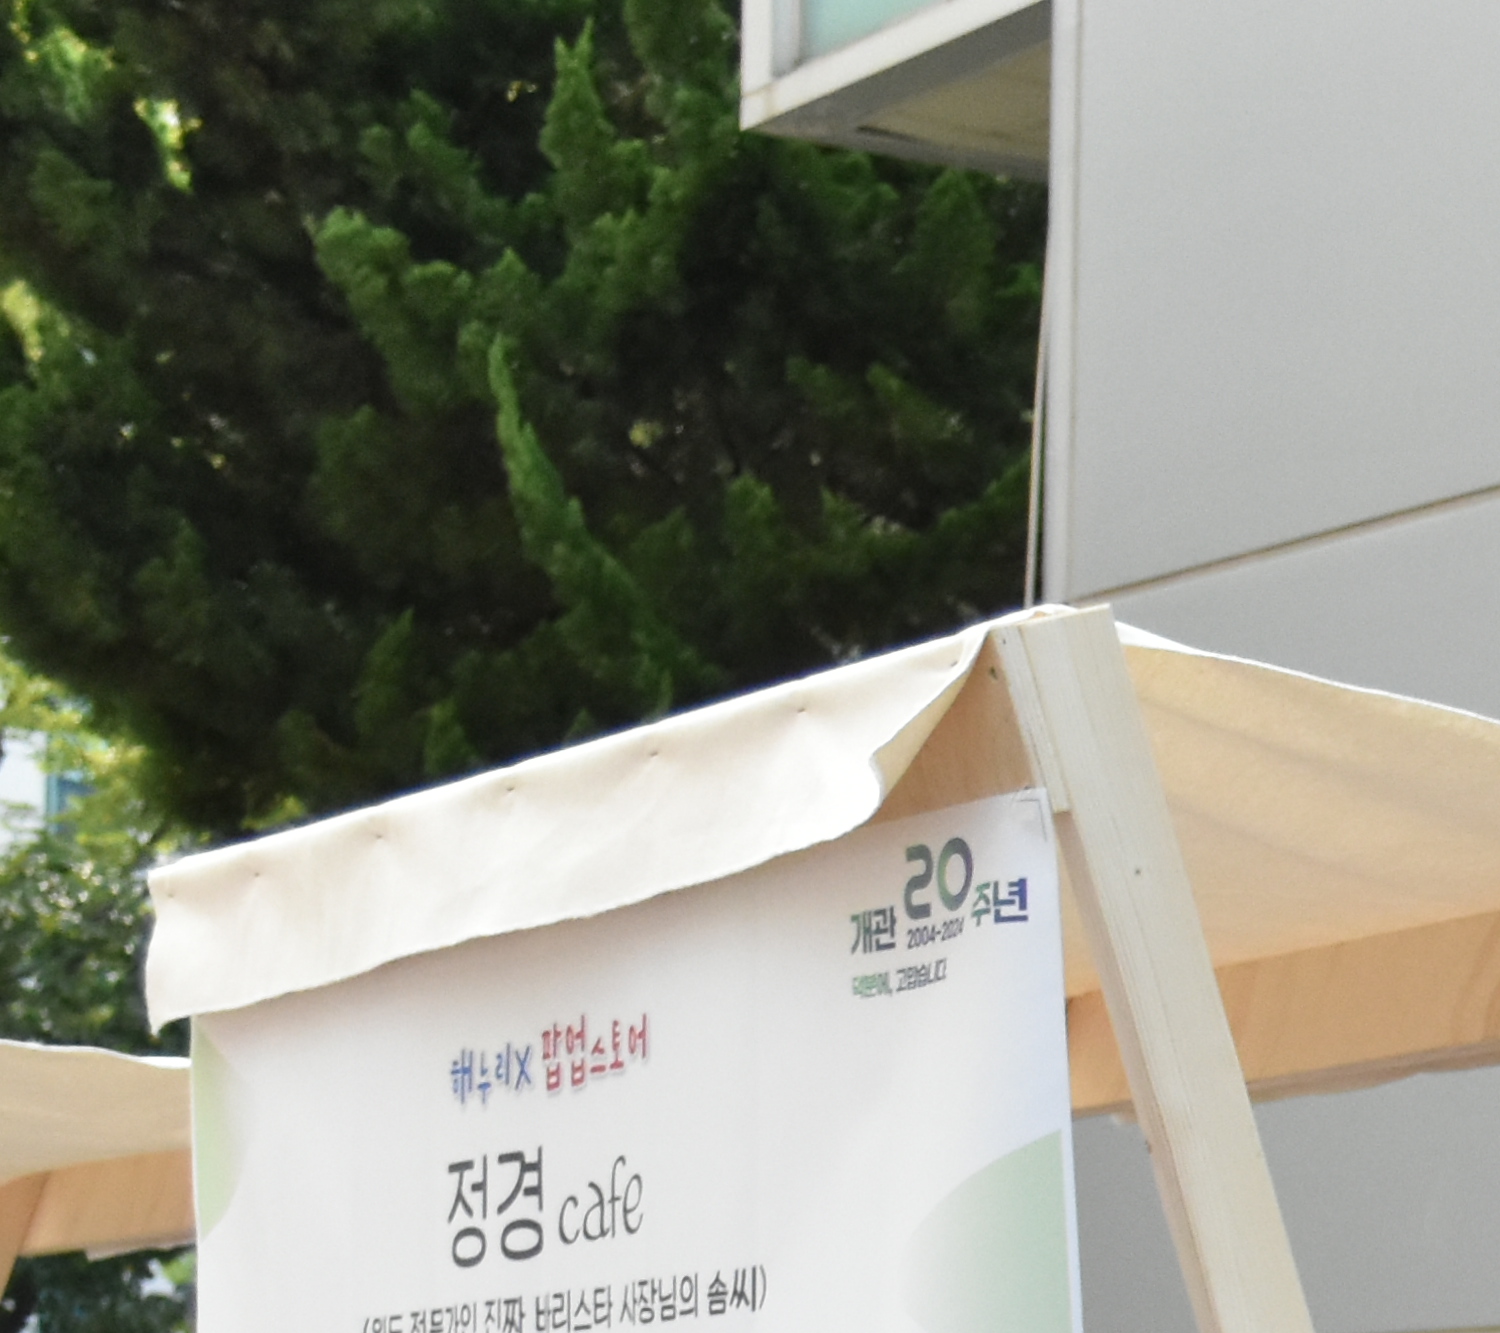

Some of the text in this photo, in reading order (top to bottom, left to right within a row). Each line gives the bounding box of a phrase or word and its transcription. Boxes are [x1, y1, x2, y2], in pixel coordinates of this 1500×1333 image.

[850, 837, 1029, 955] 개관 20 주년
[541, 1013, 648, 1092] 팝업스토어
[447, 1145, 644, 1268] 정경 cafe
[619, 1272, 701, 1326] 사장님의
[706, 1263, 769, 1318] 솜씨)
